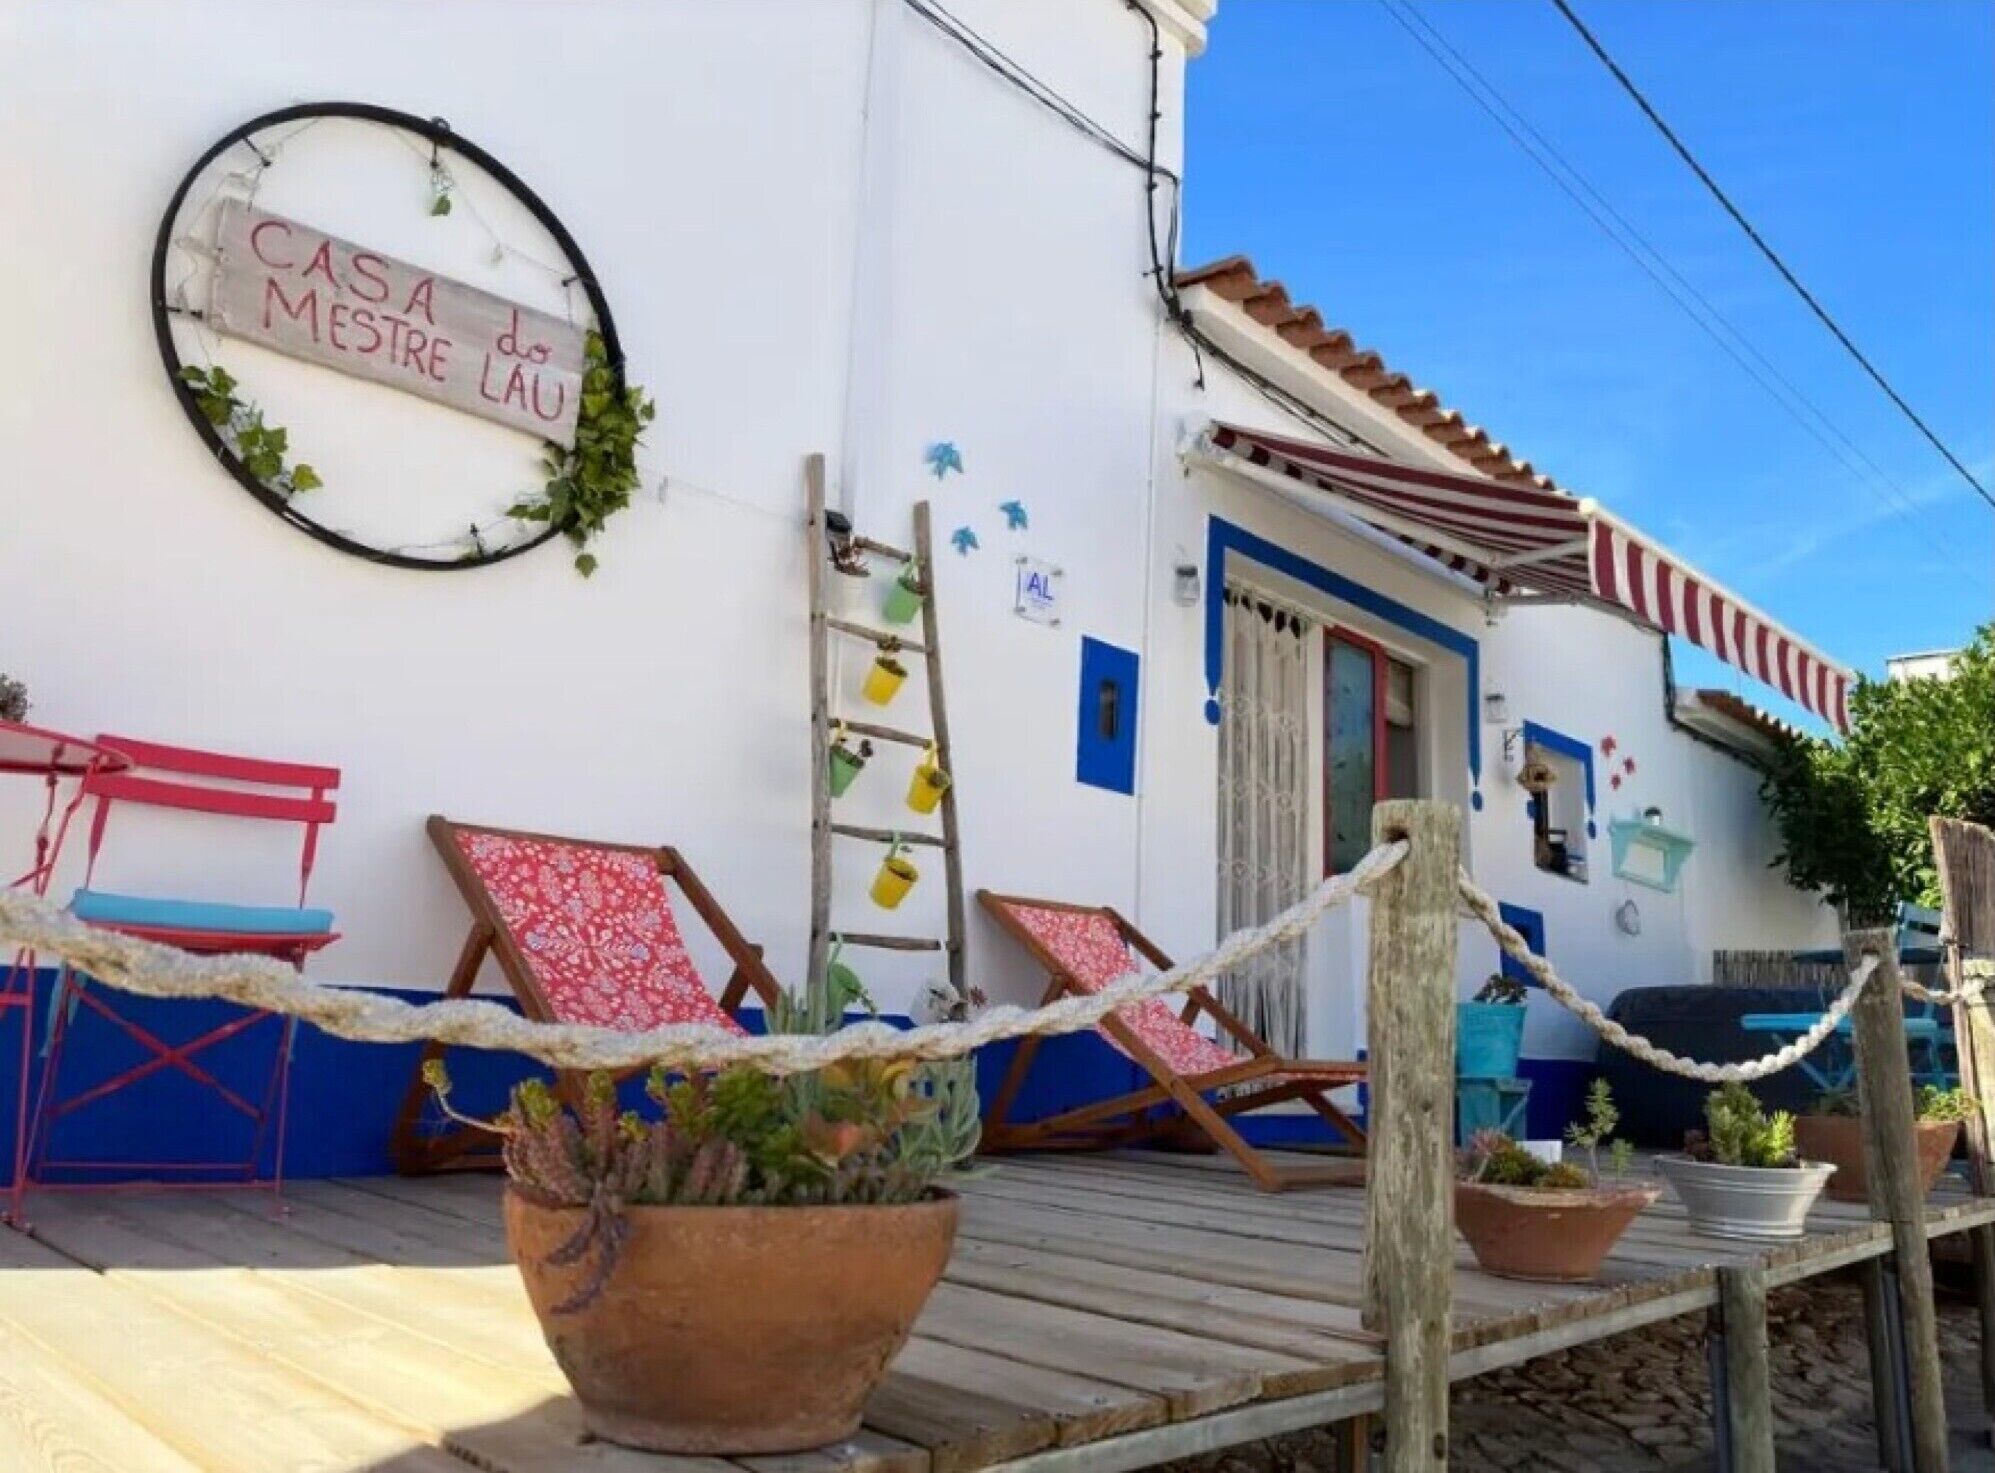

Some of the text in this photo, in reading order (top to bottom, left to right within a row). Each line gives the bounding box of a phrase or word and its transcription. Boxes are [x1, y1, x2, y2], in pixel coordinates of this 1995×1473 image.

[250, 220, 551, 364] CASA do
[263, 277, 453, 382] MESTRE
[1026, 572, 1053, 600] AL
